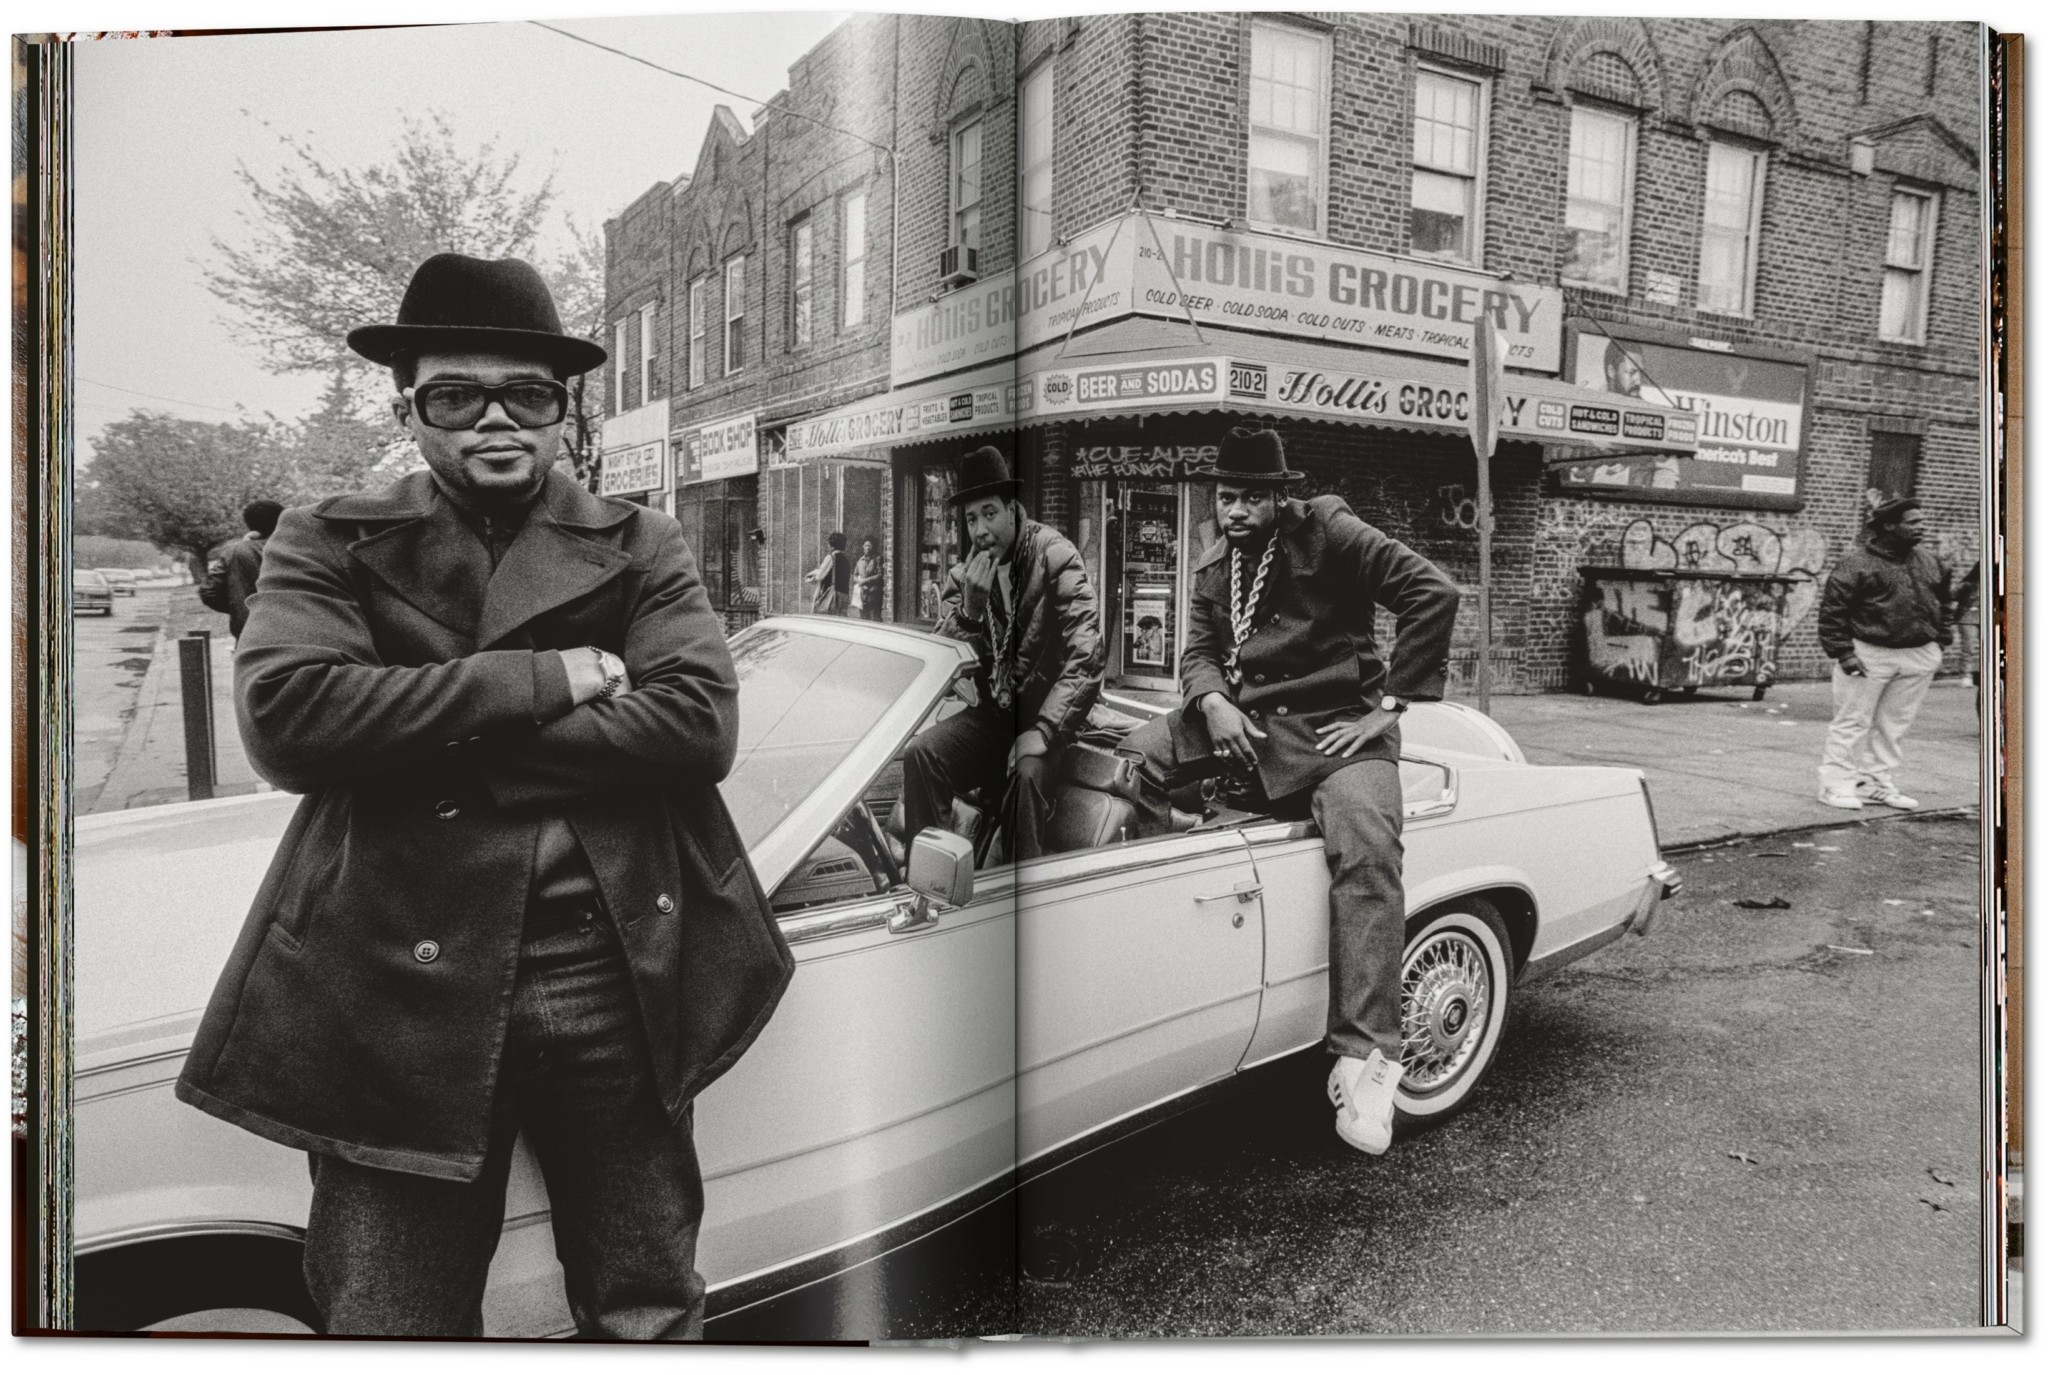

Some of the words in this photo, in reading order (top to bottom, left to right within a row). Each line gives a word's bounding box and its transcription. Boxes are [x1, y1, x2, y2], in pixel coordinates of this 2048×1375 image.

[986, 244, 1107, 328] GROCERY
[1329, 262, 1542, 333] GROCERY
[1081, 291, 1121, 316] PRODUCTS
[1145, 288, 1176, 305] COLD
[1179, 294, 1214, 311] BEER
[1222, 300, 1254, 316] COLD
[1254, 305, 1288, 322] SODA
[1298, 312, 1330, 327] COLD
[1332, 316, 1366, 333] CUTS
[1374, 324, 1414, 341] MEATS
[1421, 330, 1470, 349] TROPICAL
[976, 392, 997, 402] TROPICAL
[1047, 382, 1068, 393] COLD
[1079, 375, 1117, 399] BEER
[1121, 378, 1142, 391] AND
[1147, 368, 1214, 393] SODAS
[975, 403, 999, 415] PRODUCTS
[1278, 371, 1389, 414] Hollis
[1400, 384, 1526, 426] GROCY
[1540, 404, 1564, 416] COLD
[805, 420, 846, 447] Hollis
[848, 408, 903, 440] GROCERY
[1539, 416, 1563, 428] CUTS
[1571, 419, 1617, 434] SANDWICHES
[1625, 414, 1663, 426] TROPICAL
[702, 428, 726, 456] BOOK
[727, 421, 753, 451] SHOP
[604, 463, 658, 492] GROCERIES
